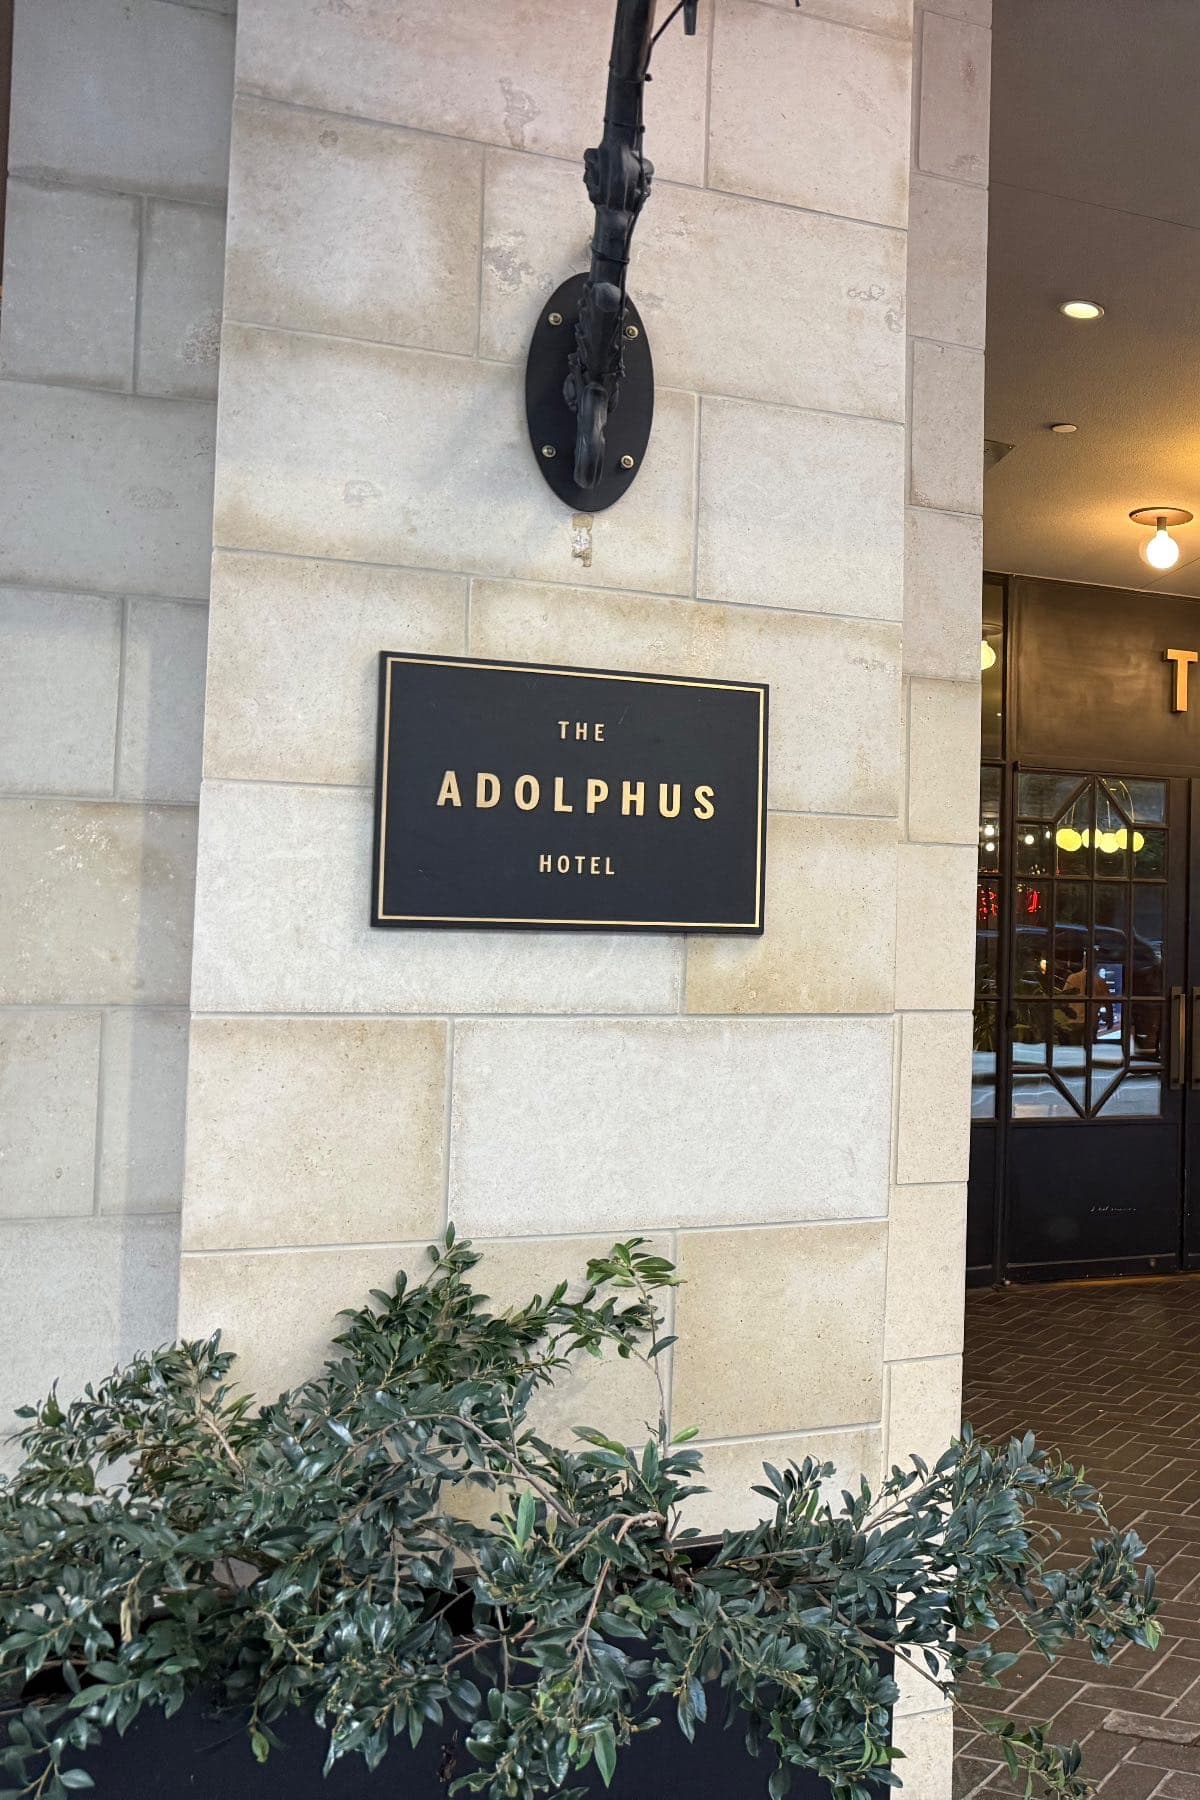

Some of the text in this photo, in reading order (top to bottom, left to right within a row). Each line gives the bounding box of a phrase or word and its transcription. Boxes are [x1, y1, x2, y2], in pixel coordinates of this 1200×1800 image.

[557, 721, 606, 742] THE
[436, 770, 716, 820] ADOLPHUS
[538, 854, 616, 875] HOTEL
